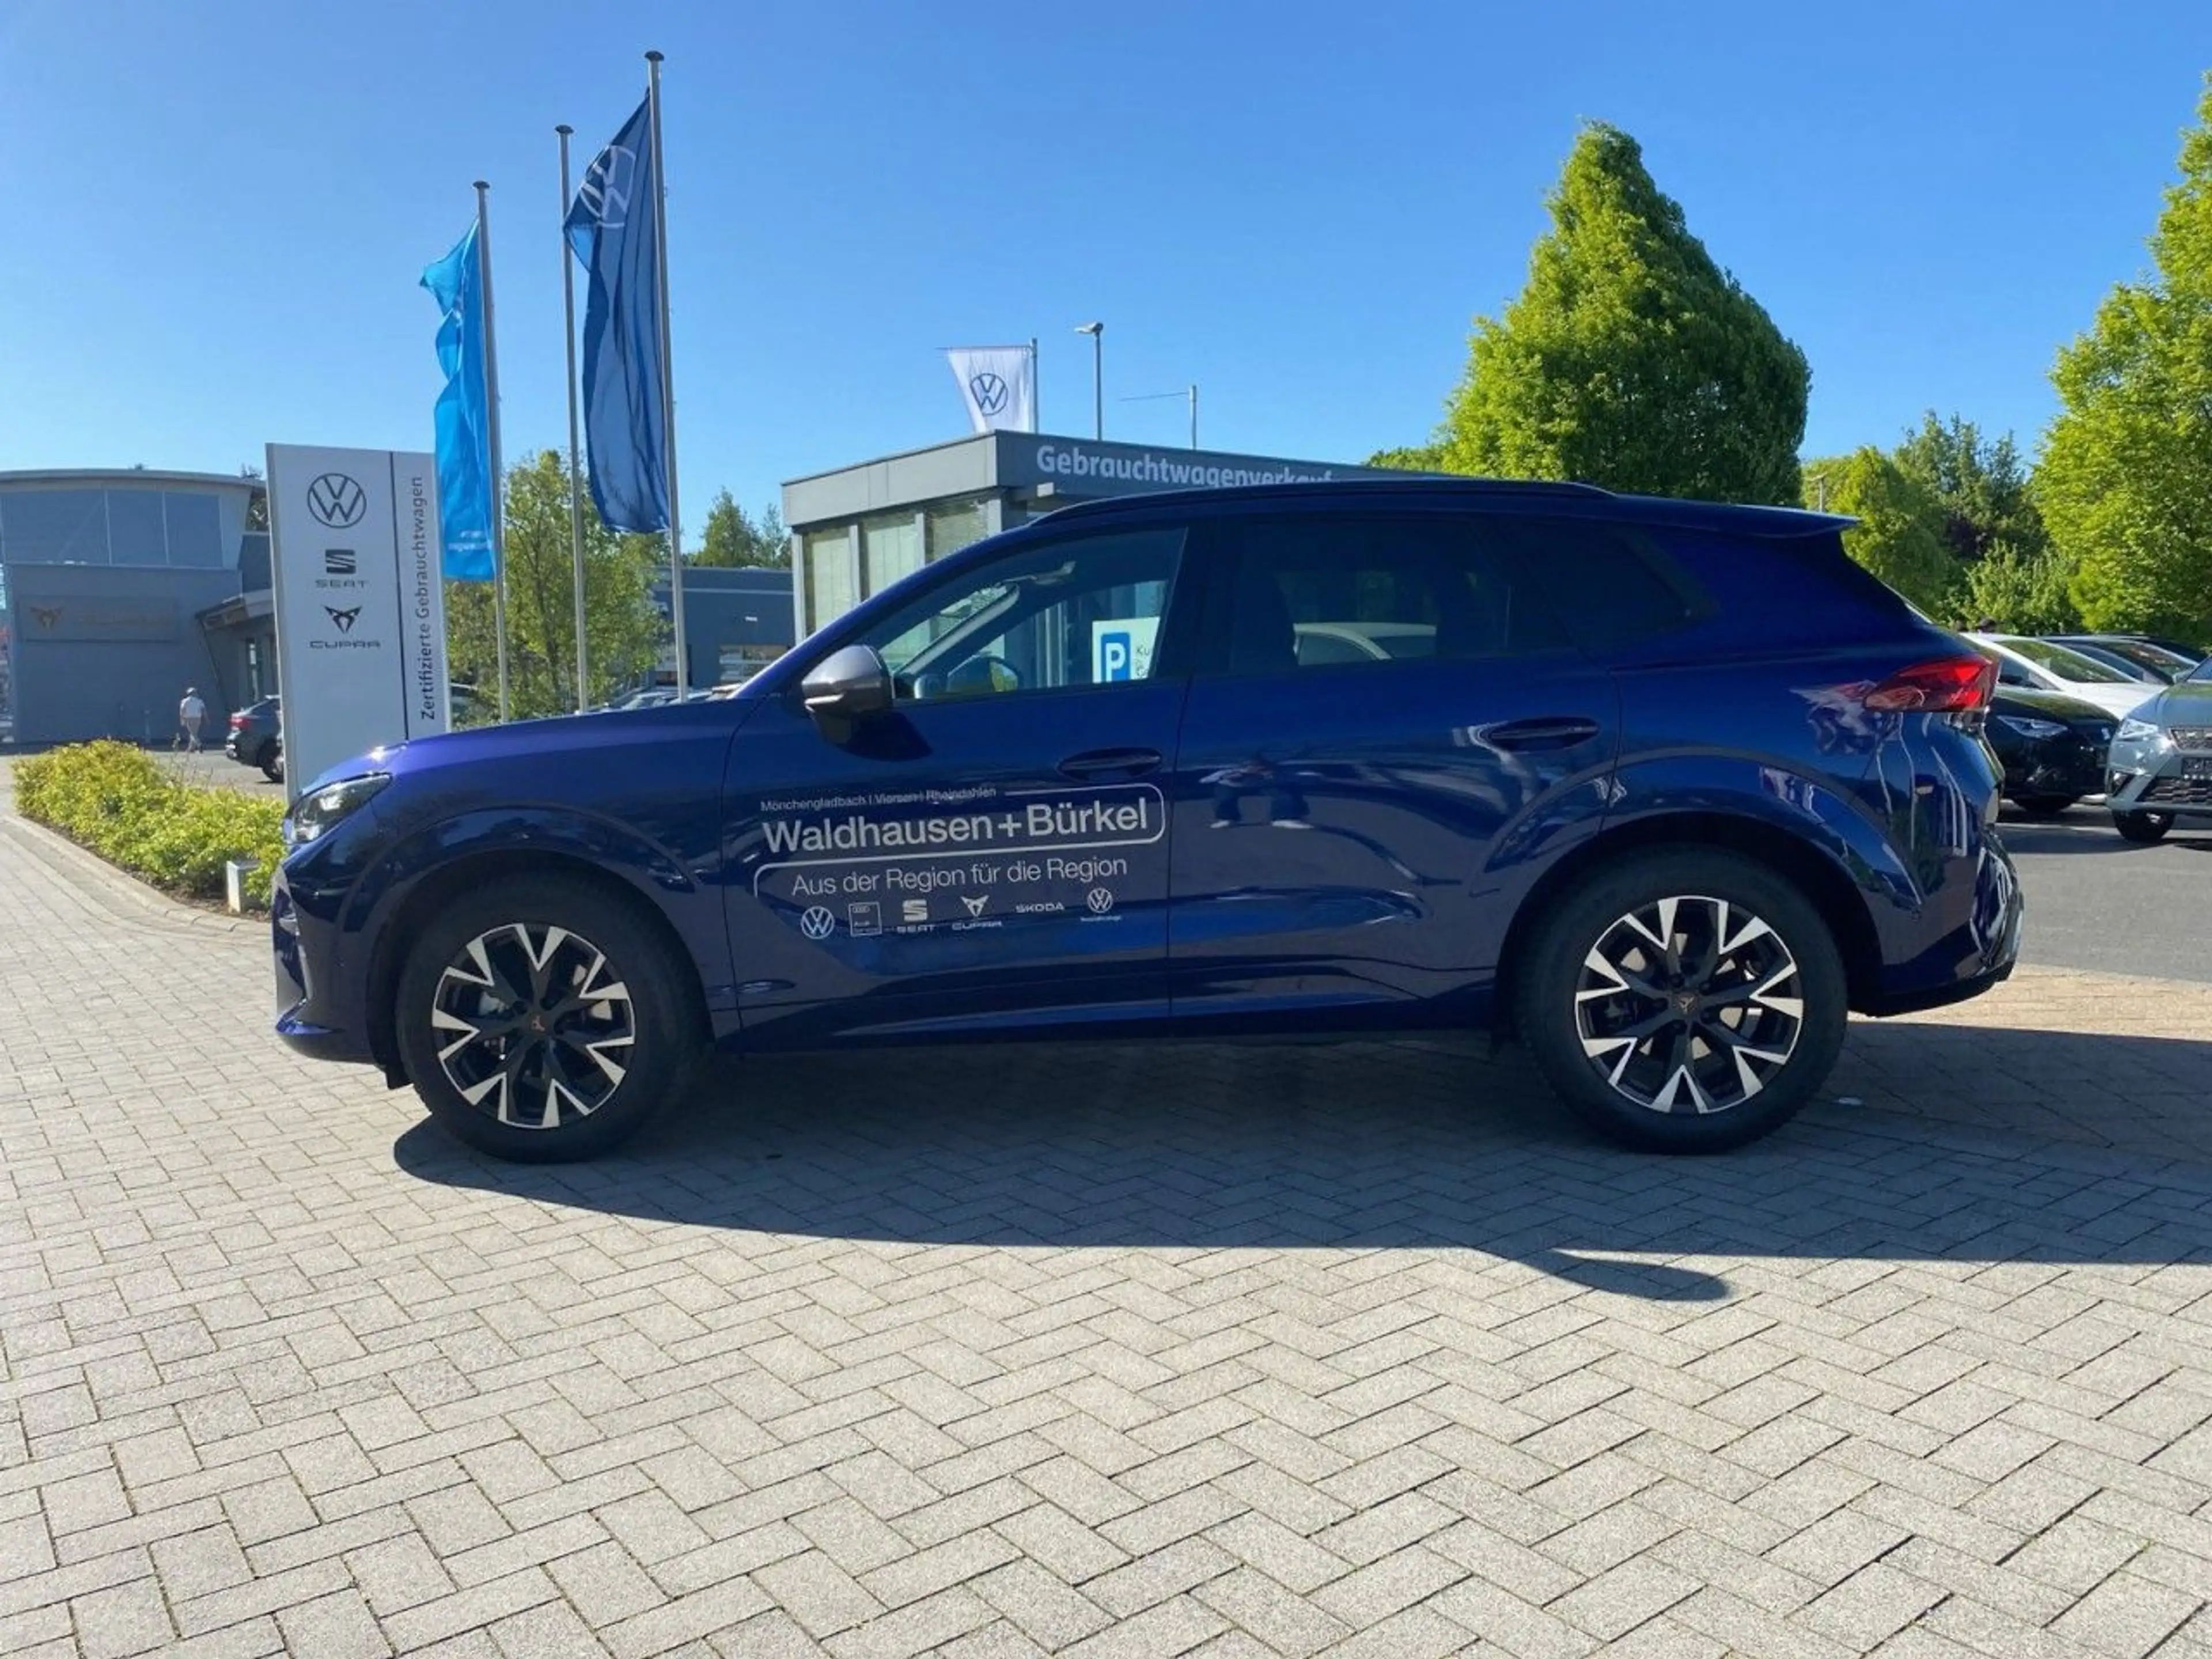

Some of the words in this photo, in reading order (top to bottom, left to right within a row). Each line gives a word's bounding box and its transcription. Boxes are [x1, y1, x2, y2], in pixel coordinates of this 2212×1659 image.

[1036, 444, 1332, 487] Gebrauchtwagenverk
[411, 476, 430, 620] Gebrauchtwagen
[315, 578, 369, 588] SEAT
[309, 640, 381, 650] CUPRA
[415, 622, 435, 720] Zertifizierte
[791, 874, 836, 896] Aus
[843, 871, 879, 892] der
[886, 866, 965, 892] Region
[970, 864, 1001, 884] für
[1007, 861, 1041, 882] die
[1047, 857, 1127, 883] Region
